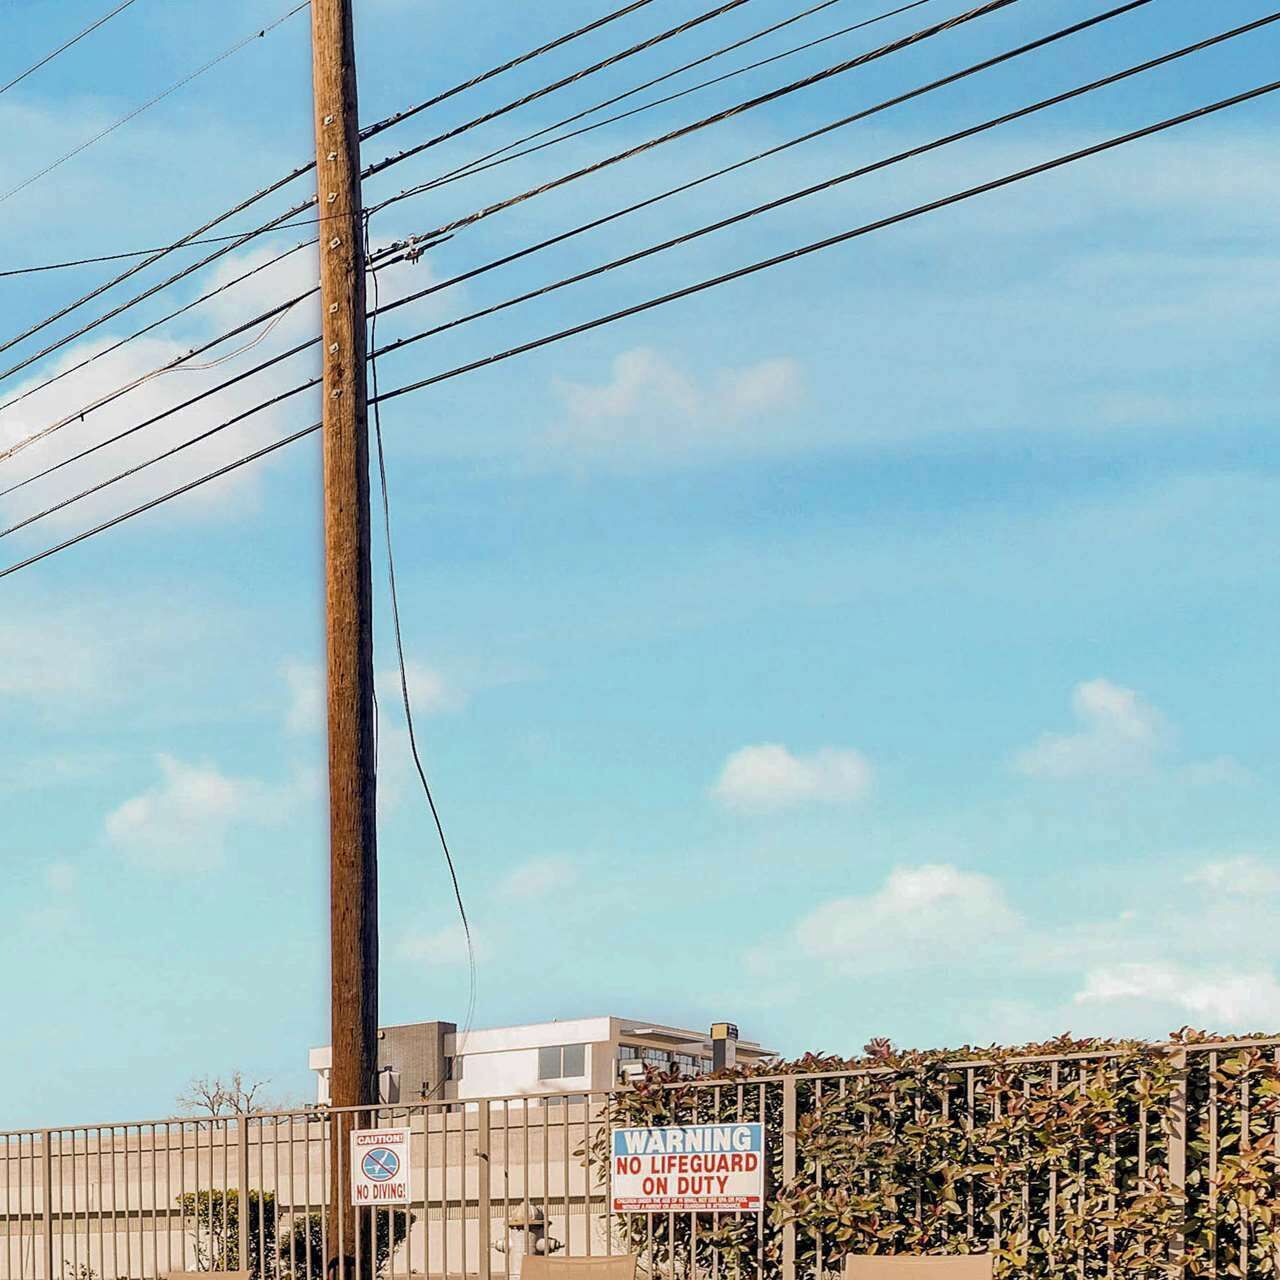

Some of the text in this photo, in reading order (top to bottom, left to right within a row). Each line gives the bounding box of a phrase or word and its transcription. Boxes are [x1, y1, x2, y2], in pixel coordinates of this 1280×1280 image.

[357, 1134, 403, 1145] CAUTION!
[624, 1126, 752, 1154] WARNING
[617, 1153, 758, 1175] NO LIFEGUARD
[356, 1183, 406, 1200] NO DIVING!
[642, 1175, 729, 1196] ON DUTY
